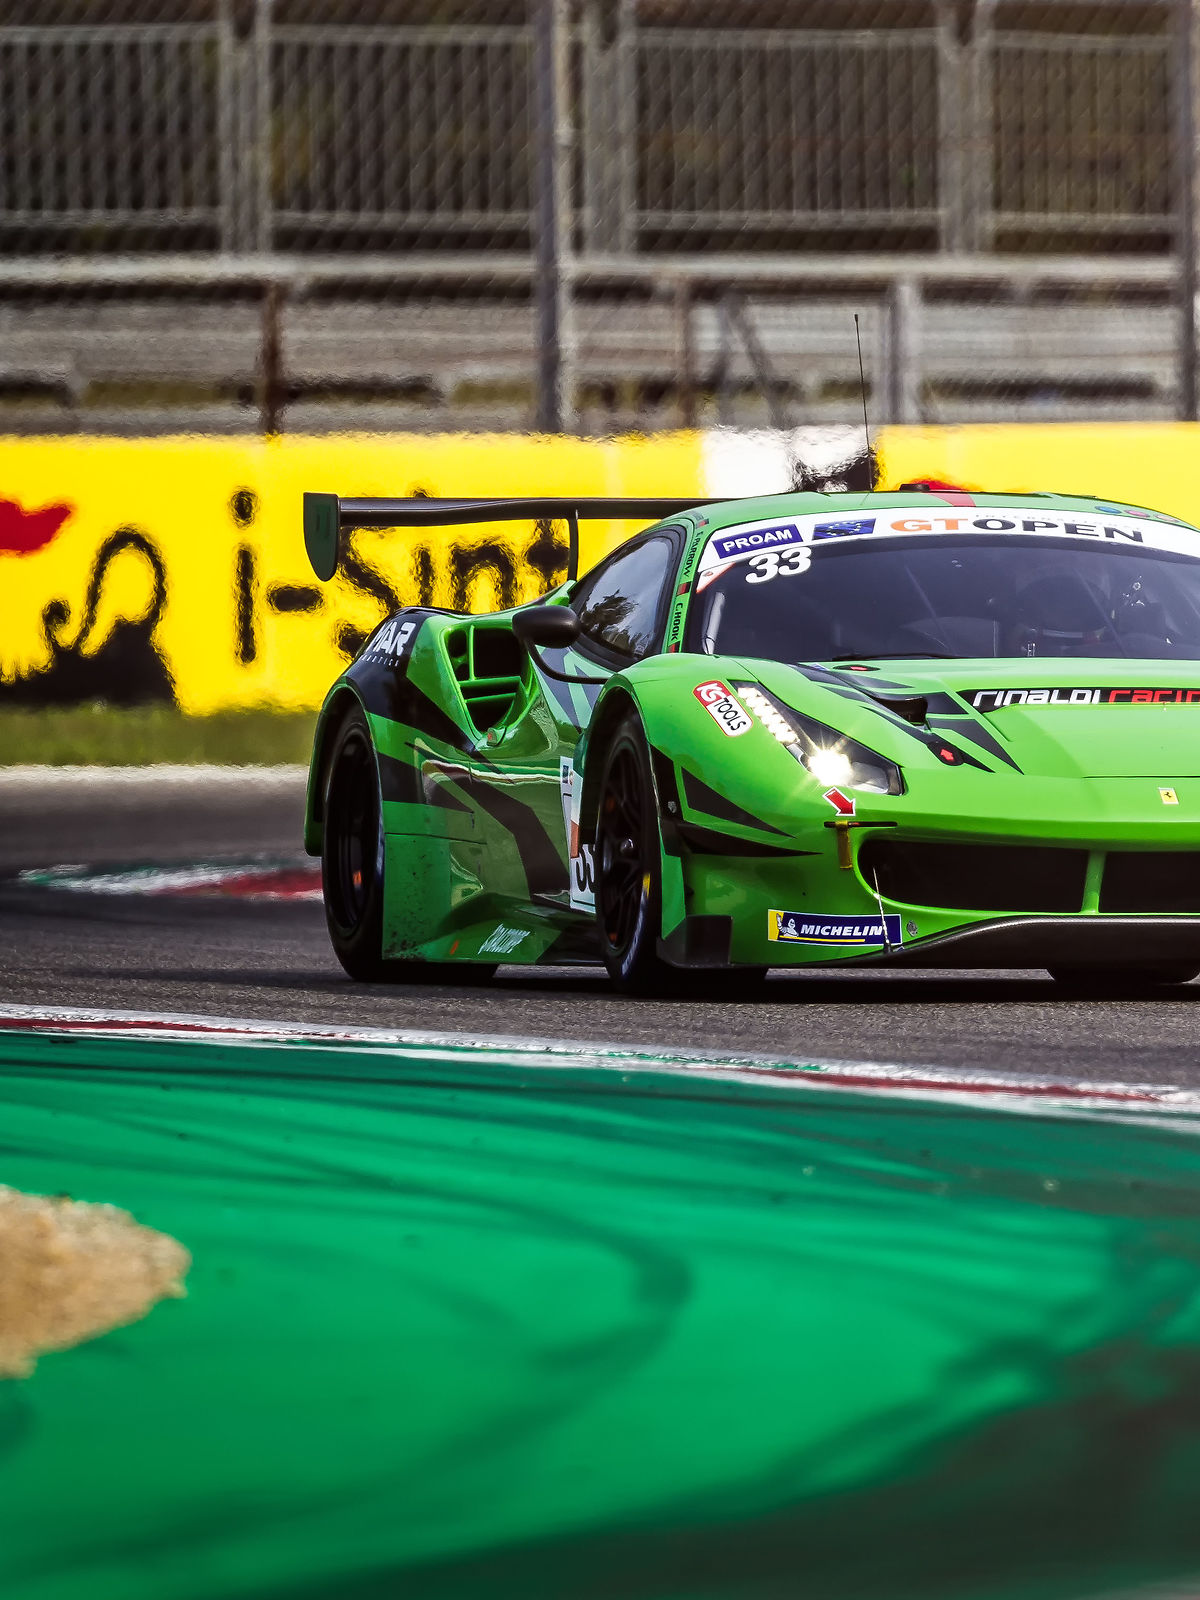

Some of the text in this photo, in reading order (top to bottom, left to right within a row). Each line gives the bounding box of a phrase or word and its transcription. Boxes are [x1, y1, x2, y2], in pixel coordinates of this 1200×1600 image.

[722, 528, 793, 552] PROAM
[745, 546, 812, 584] 33
[713, 697, 747, 731] TOOLS
[800, 923, 885, 937] MICHELIN
